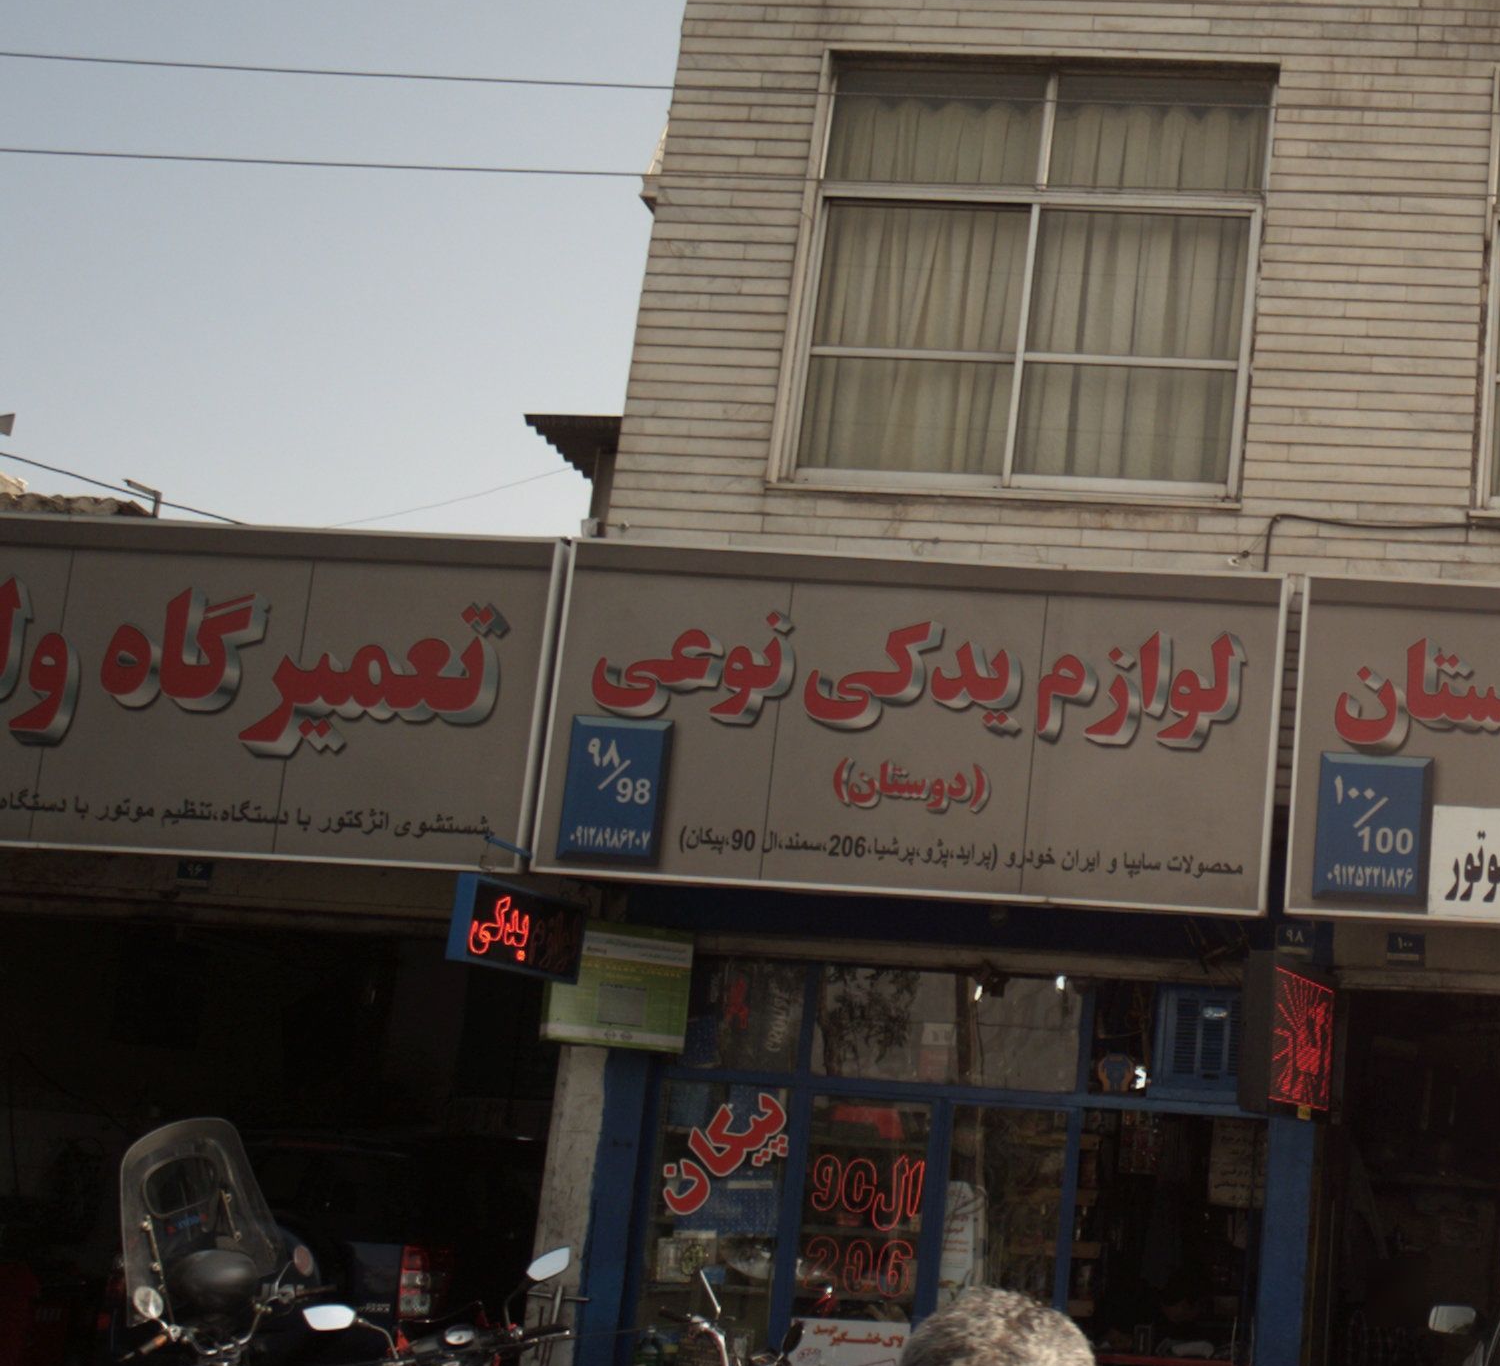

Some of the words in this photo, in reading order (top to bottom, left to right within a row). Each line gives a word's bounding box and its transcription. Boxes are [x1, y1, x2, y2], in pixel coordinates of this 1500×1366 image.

[589, 609, 796, 727] نوعی
[802, 619, 1021, 735] یدکی
[1036, 627, 1247, 748] لوازم
[587, 737, 621, 768] ۹۸
[615, 777, 651, 805] 98
[832, 755, 992, 814] (دوستان)
[1333, 774, 1377, 806] ۱۰۰
[74, 794, 89, 820] با
[96, 797, 155, 823] موتور
[296, 806, 312, 831] با
[317, 807, 390, 835] انژکتور
[1356, 825, 1415, 855] 100
[1004, 846, 1056, 870] خودرو
[1061, 848, 1101, 874] ایران
[1106, 855, 1118, 874] و
[1122, 851, 1162, 879] سایپا
[1166, 852, 1244, 879] محصولات
[467, 894, 532, 963] یدکی
[662, 1091, 789, 1216] پیکان
[803, 1235, 914, 1299] 206
